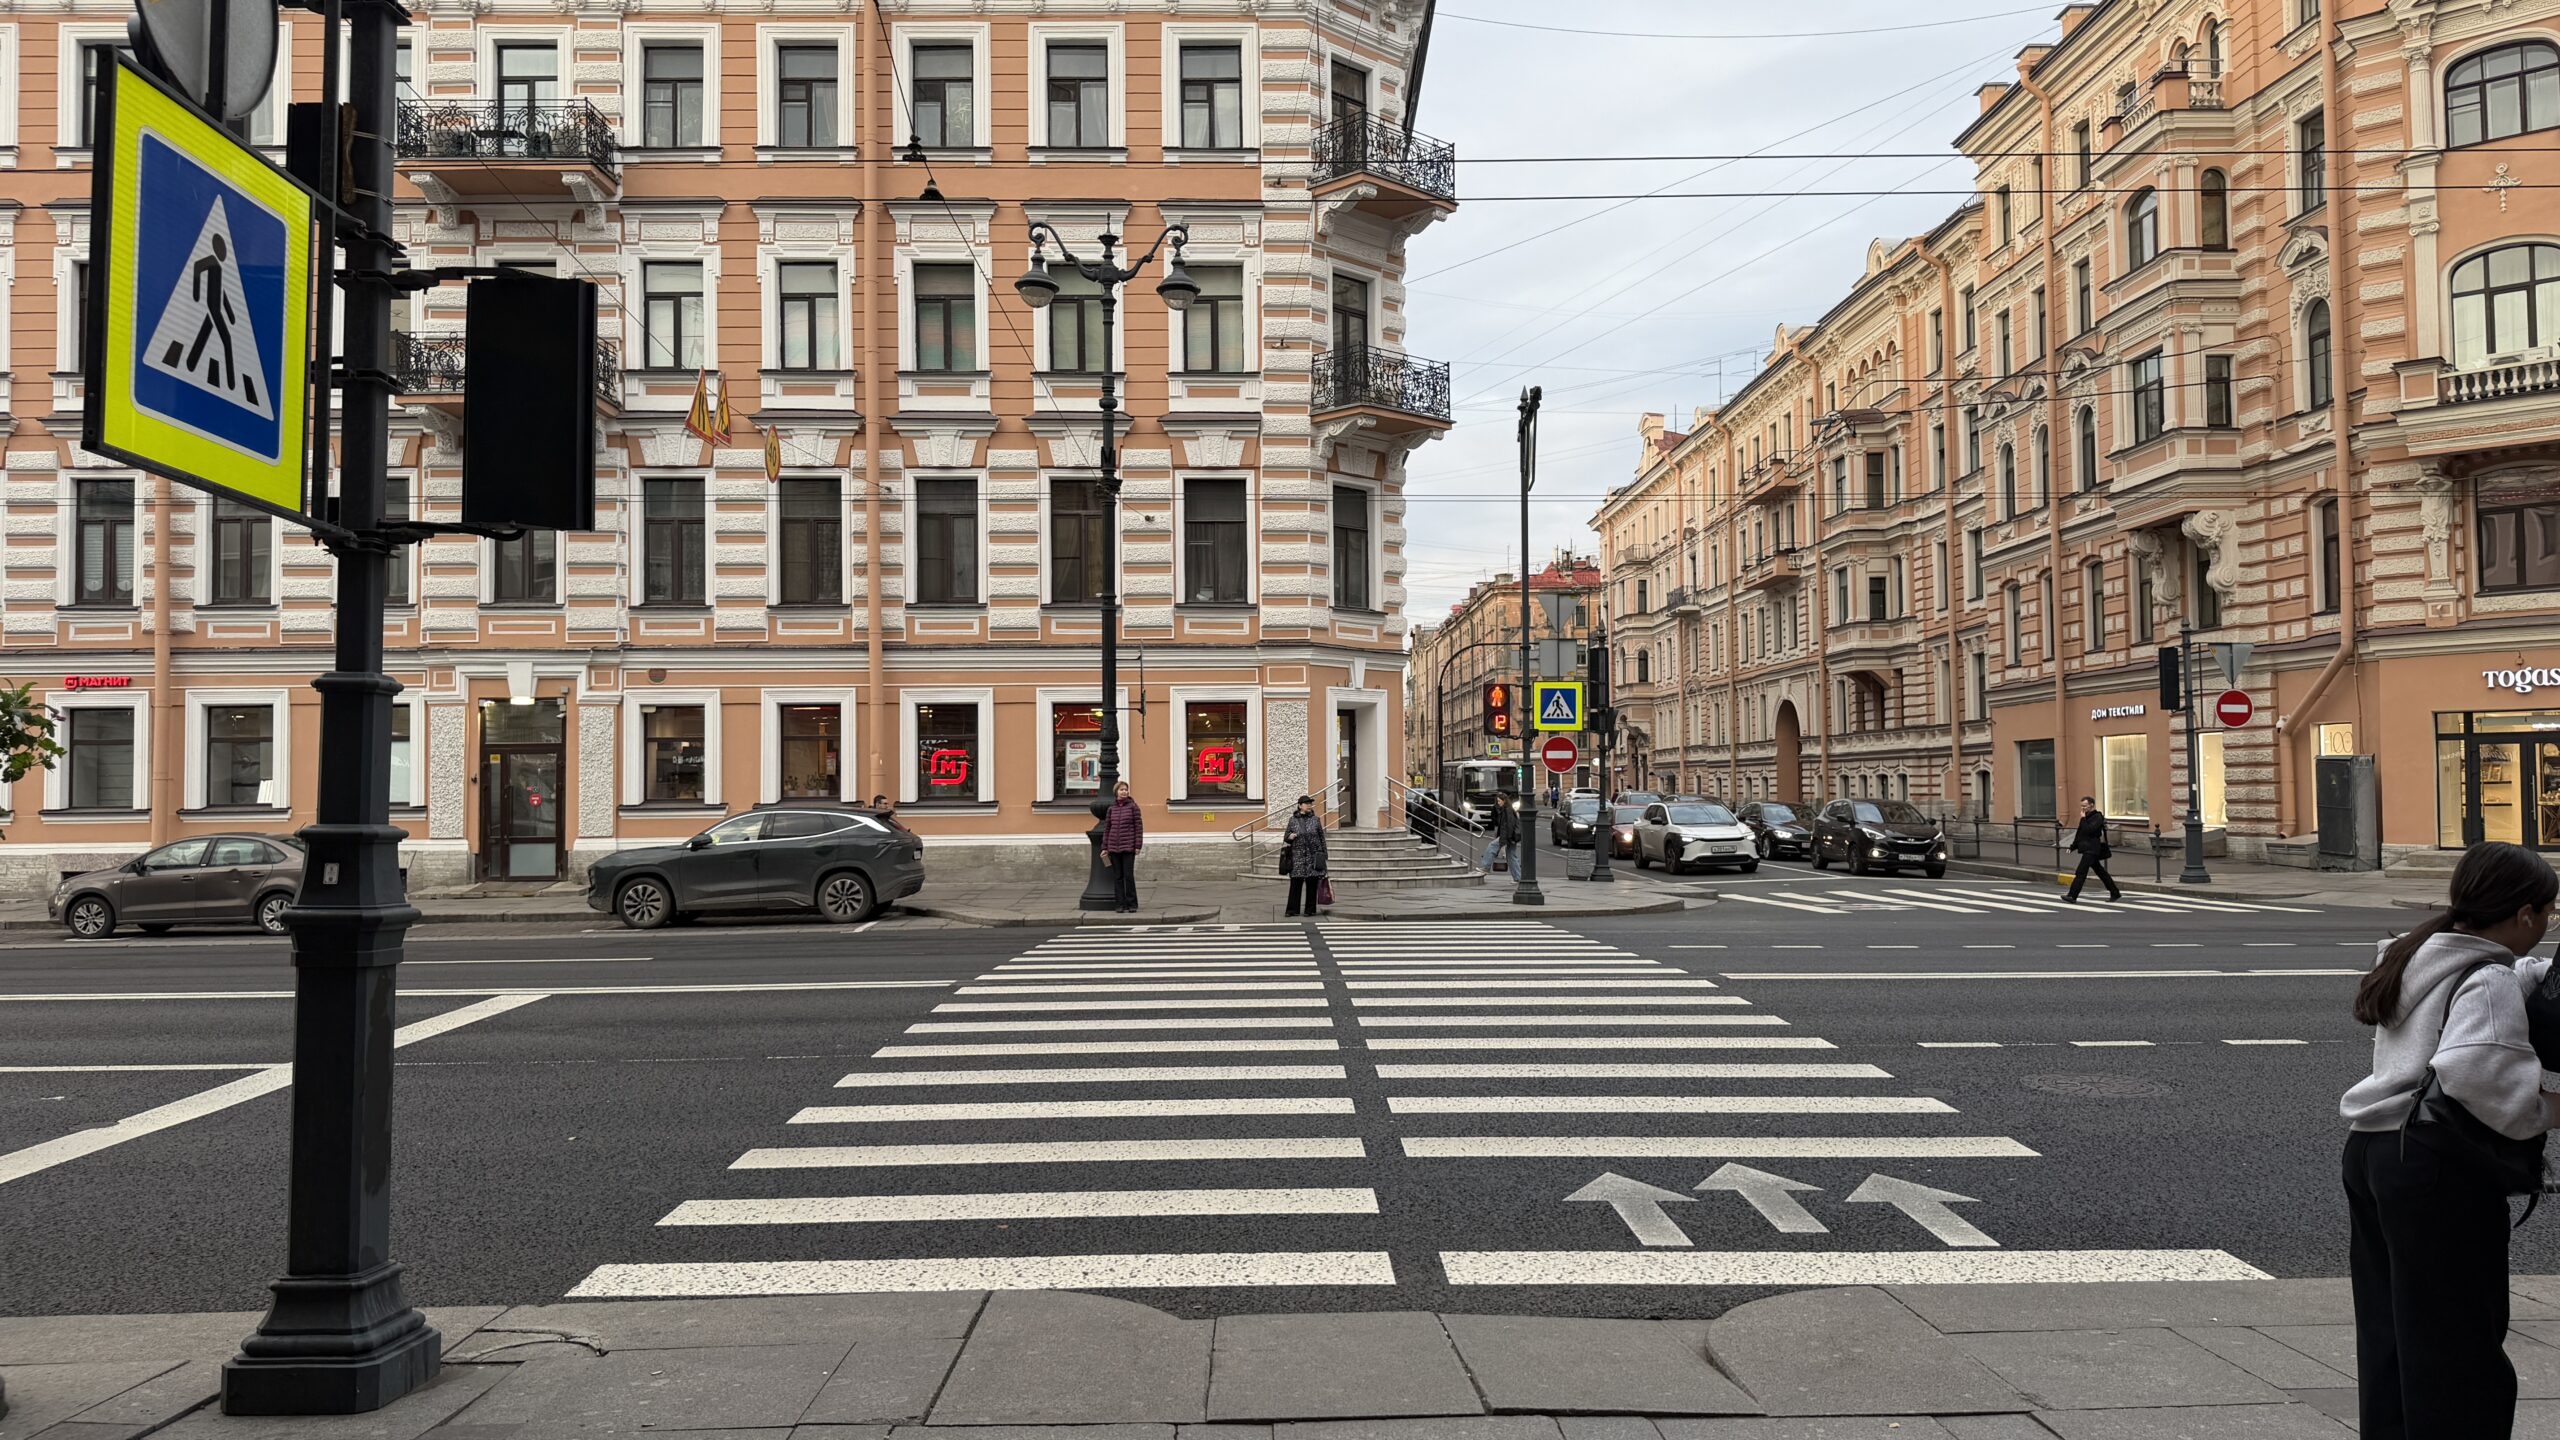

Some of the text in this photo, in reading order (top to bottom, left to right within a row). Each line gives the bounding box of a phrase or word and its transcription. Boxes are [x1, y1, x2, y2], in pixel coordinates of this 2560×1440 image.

[79, 676, 129, 687] МАГНИТ
[2091, 704, 2144, 720] ДОМ ТЕКСТИЛЯ
[1495, 714, 1506, 730] 12
